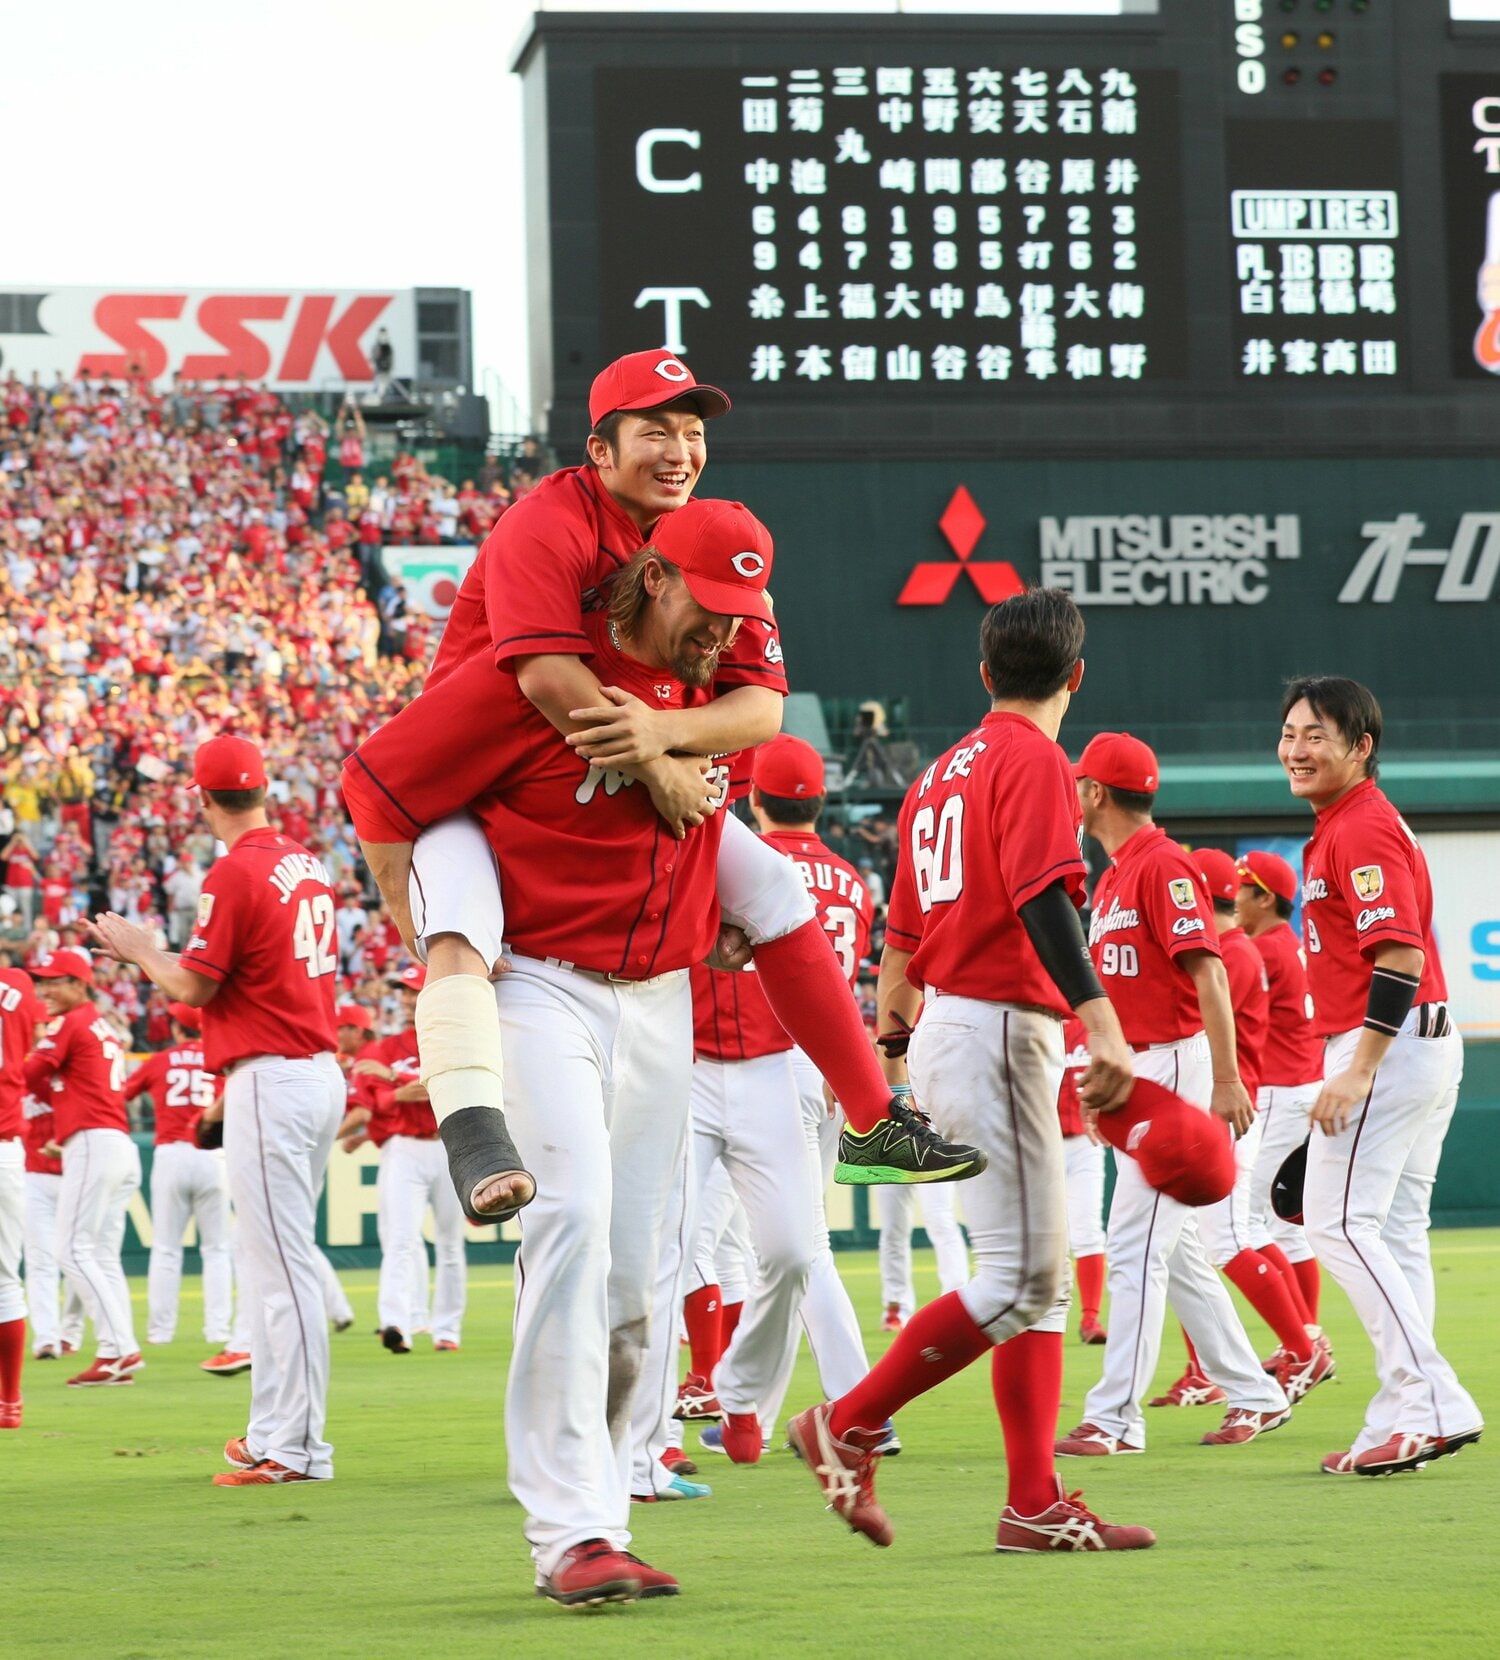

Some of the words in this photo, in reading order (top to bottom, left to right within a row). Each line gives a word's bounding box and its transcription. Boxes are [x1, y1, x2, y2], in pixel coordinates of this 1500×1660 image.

[1235, 23, 1264, 58] S
[742, 76, 777, 87] 一
[787, 69, 823, 92] 二
[832, 67, 868, 95] 三
[876, 67, 912, 95] 四
[922, 68, 958, 95] 五
[966, 67, 1003, 95] 六
[1011, 68, 1047, 96] 七
[1057, 68, 1093, 95] 八
[1101, 68, 1137, 96] 九
[635, 128, 702, 194] C
[835, 127, 870, 164] 丸
[752, 206, 775, 234] 6
[798, 206, 820, 234] 4
[842, 206, 865, 234] 8
[891, 206, 906, 234] 1
[933, 206, 956, 234] 9
[978, 206, 1000, 234] 5
[1023, 206, 1045, 234] 7
[1068, 206, 1090, 234] 2
[1112, 206, 1135, 234] 3
[1242, 200, 1389, 230] UMPIRES
[754, 242, 777, 270] 9
[799, 242, 821, 270] 4
[845, 241, 867, 269] 7
[890, 241, 912, 269] 3
[933, 241, 957, 269] 8
[979, 241, 1002, 269] 5
[1018, 241, 1053, 269] 打
[1069, 241, 1091, 269] 6
[1114, 241, 1136, 269] 2
[75, 294, 396, 381] SSK
[634, 286, 710, 354] T
[795, 283, 832, 380] 上本
[885, 283, 921, 380] 大山
[1041, 515, 1299, 559] MITSUBISHI
[1042, 560, 1267, 605] ELECTRIC
[911, 794, 964, 914] 60
[269, 854, 331, 904] JOHNSON
[787, 855, 864, 911] BUTA
[293, 894, 337, 978] 42
[1356, 906, 1396, 932] Carp
[1101, 943, 1139, 977] 90
[166, 1069, 216, 1107] 25
